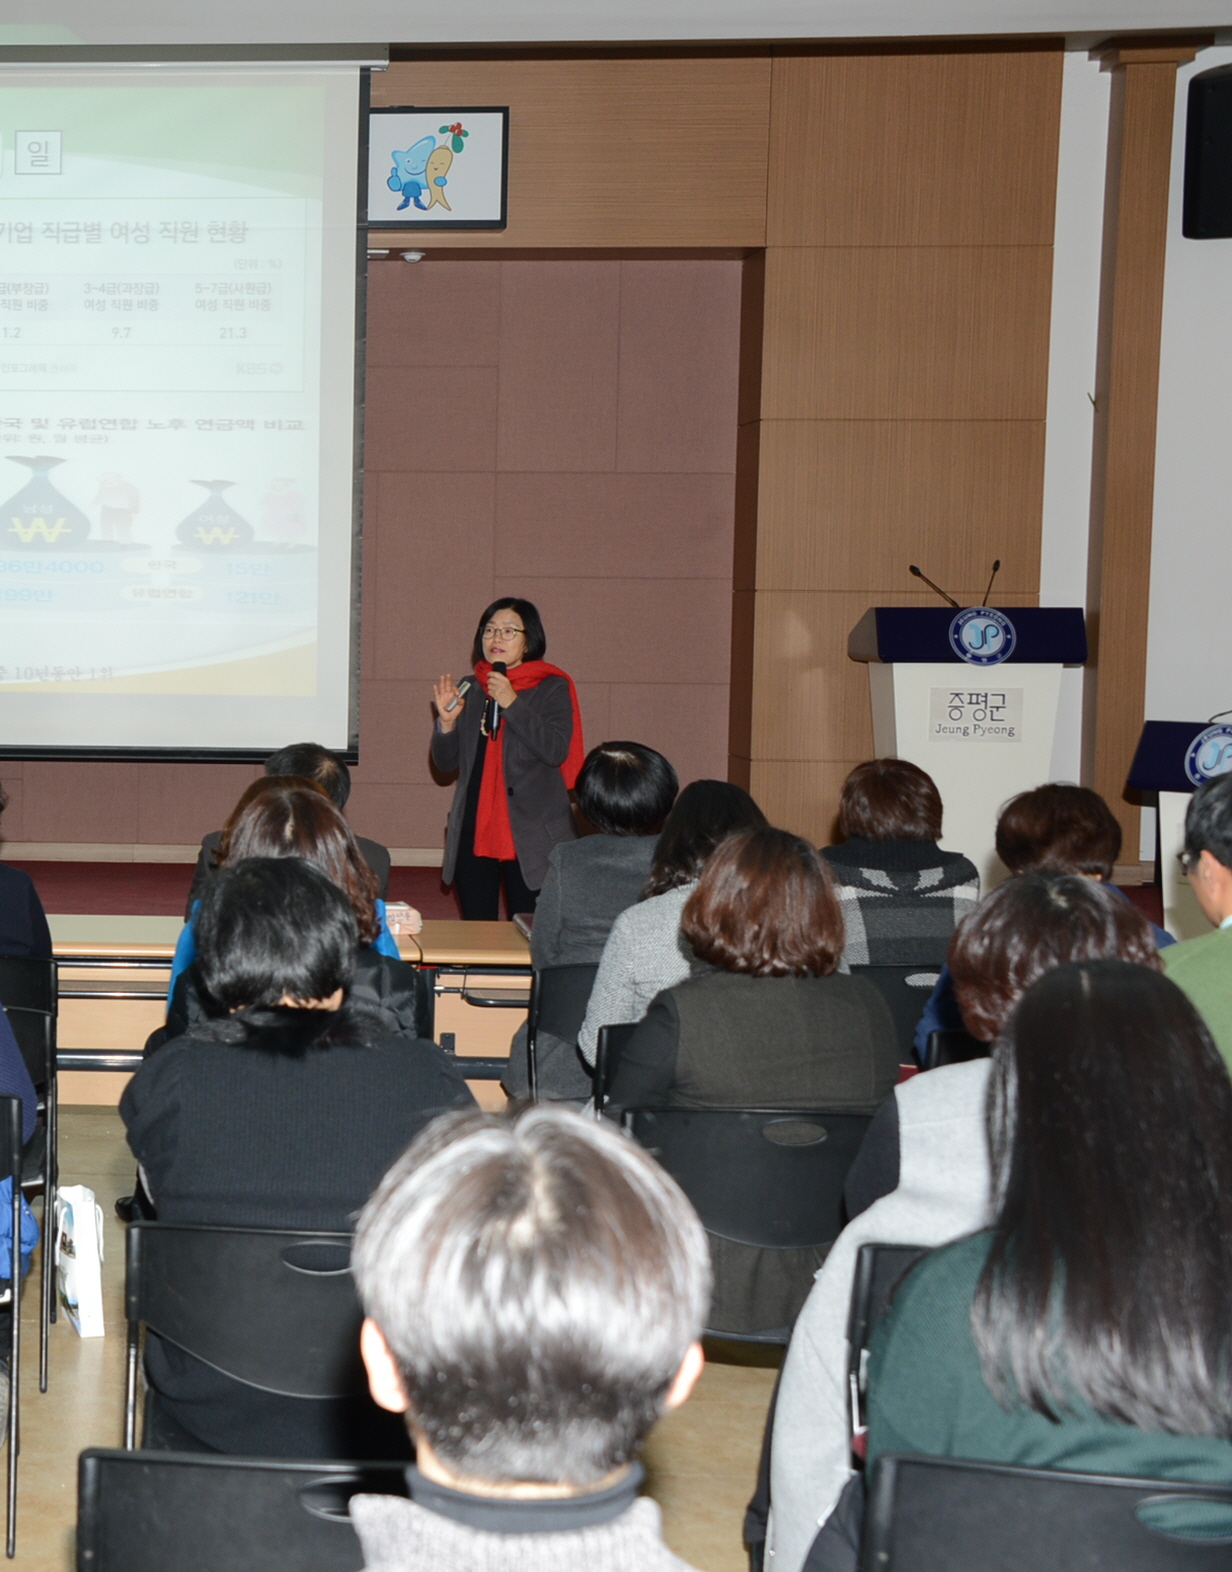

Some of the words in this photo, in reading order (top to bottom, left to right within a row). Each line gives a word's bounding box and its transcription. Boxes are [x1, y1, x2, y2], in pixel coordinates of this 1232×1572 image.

[27, 140, 50, 167] 일
[41, 221, 102, 244] 직급별
[110, 221, 150, 244] 여성
[159, 221, 198, 244] 직원
[206, 221, 248, 244] 현황
[0, 298, 22, 311] 직원
[27, 298, 49, 311] 비중
[84, 298, 106, 311] 여성
[110, 298, 133, 311] 직원
[137, 298, 159, 311] 비중
[195, 298, 217, 311] 여성
[222, 298, 244, 311] 직원
[248, 298, 271, 311] 비중
[3, 327, 21, 339] 1.2
[112, 327, 131, 339] 9.7
[220, 327, 247, 339] 21.3
[31, 418, 49, 430] 및
[57, 418, 139, 431] 유럽연합
[146, 418, 187, 431] 노후
[195, 418, 255, 431] 연금액
[264, 418, 305, 431] 비교
[948, 692, 1006, 722] 증평군
[935, 723, 969, 737] Jeung
[973, 724, 1015, 737] Pyeong
